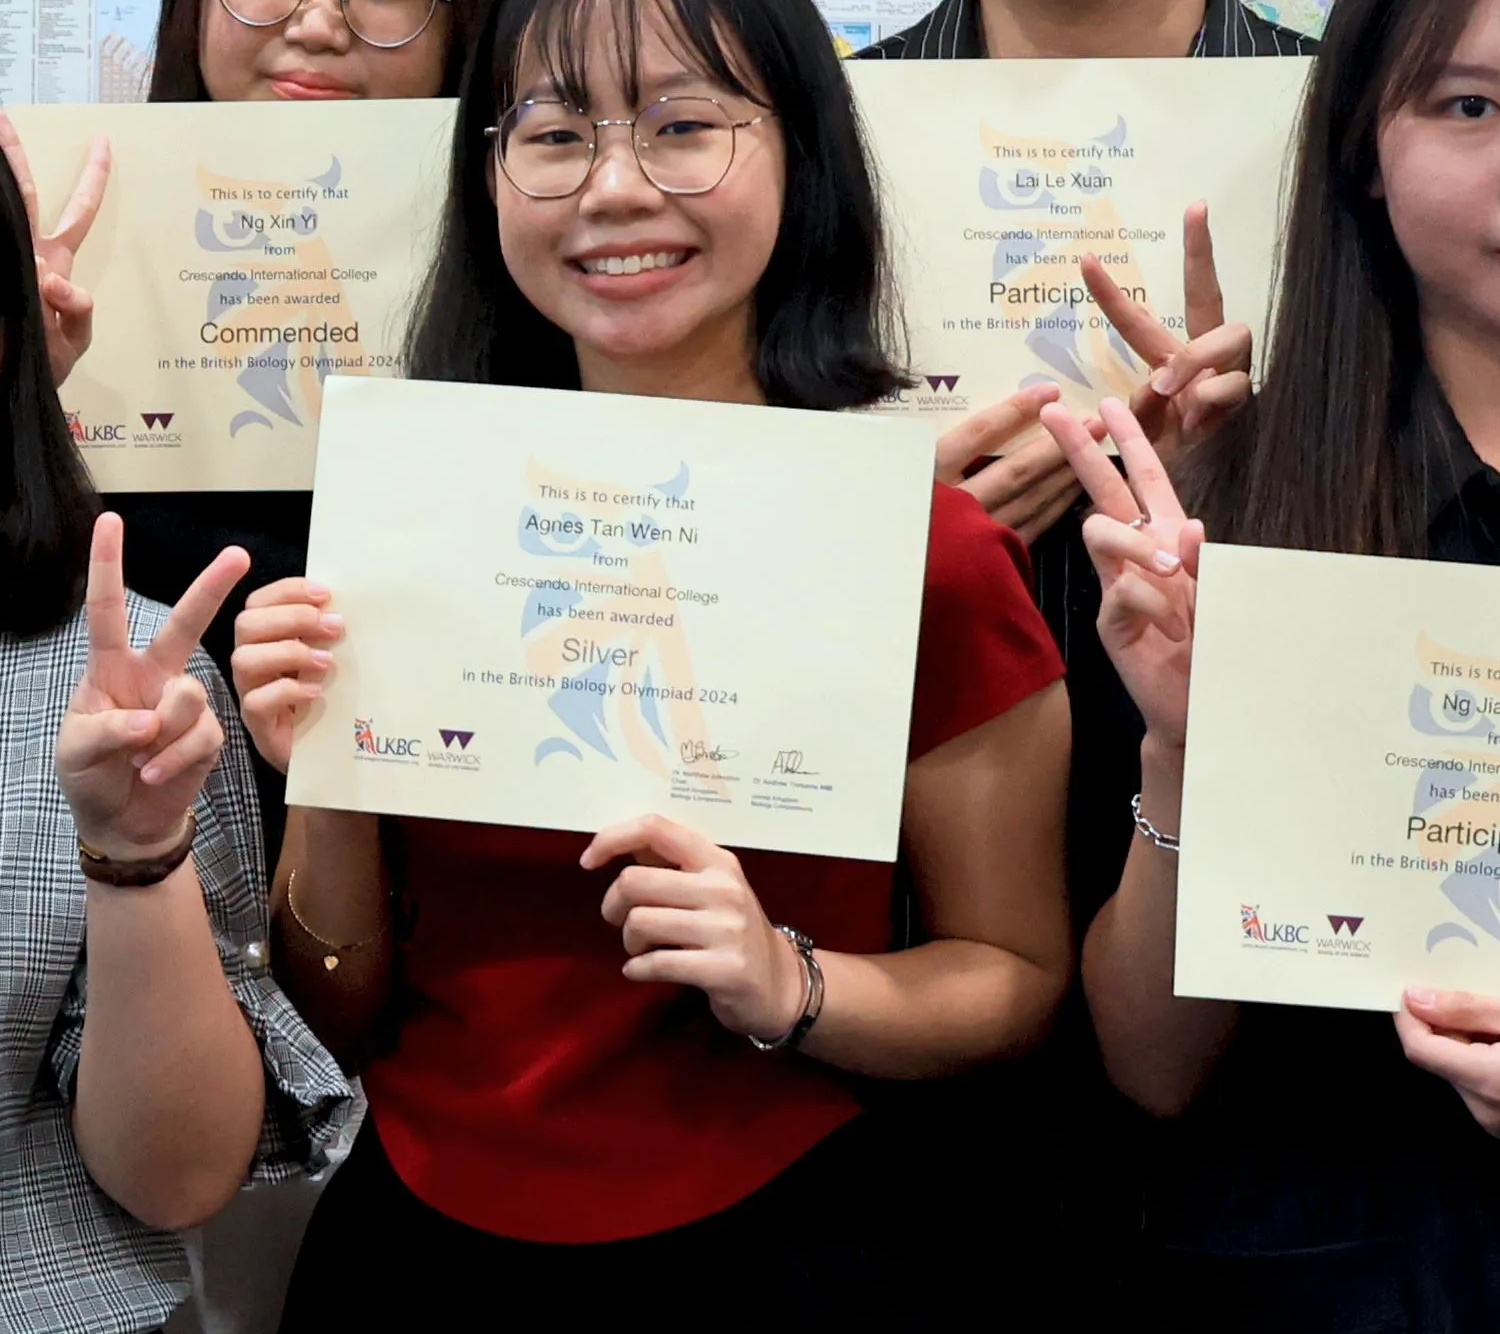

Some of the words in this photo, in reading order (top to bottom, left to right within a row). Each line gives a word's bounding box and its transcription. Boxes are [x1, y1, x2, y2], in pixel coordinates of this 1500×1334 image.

[1015, 173, 1040, 188] Lai
[1045, 173, 1066, 188] Le
[1070, 172, 1113, 188] Xuan
[241, 214, 265, 234] Ng
[269, 214, 296, 229] Xin
[300, 213, 317, 230] Yi
[200, 321, 359, 344] Commended
[525, 514, 584, 536] Agnes
[590, 518, 624, 537] Tan
[630, 522, 672, 542] Wen
[678, 526, 698, 544] Ni
[561, 637, 639, 667] Silver
[1442, 693, 1471, 717] Ng
[1315, 938, 1373, 953] WARWICK
